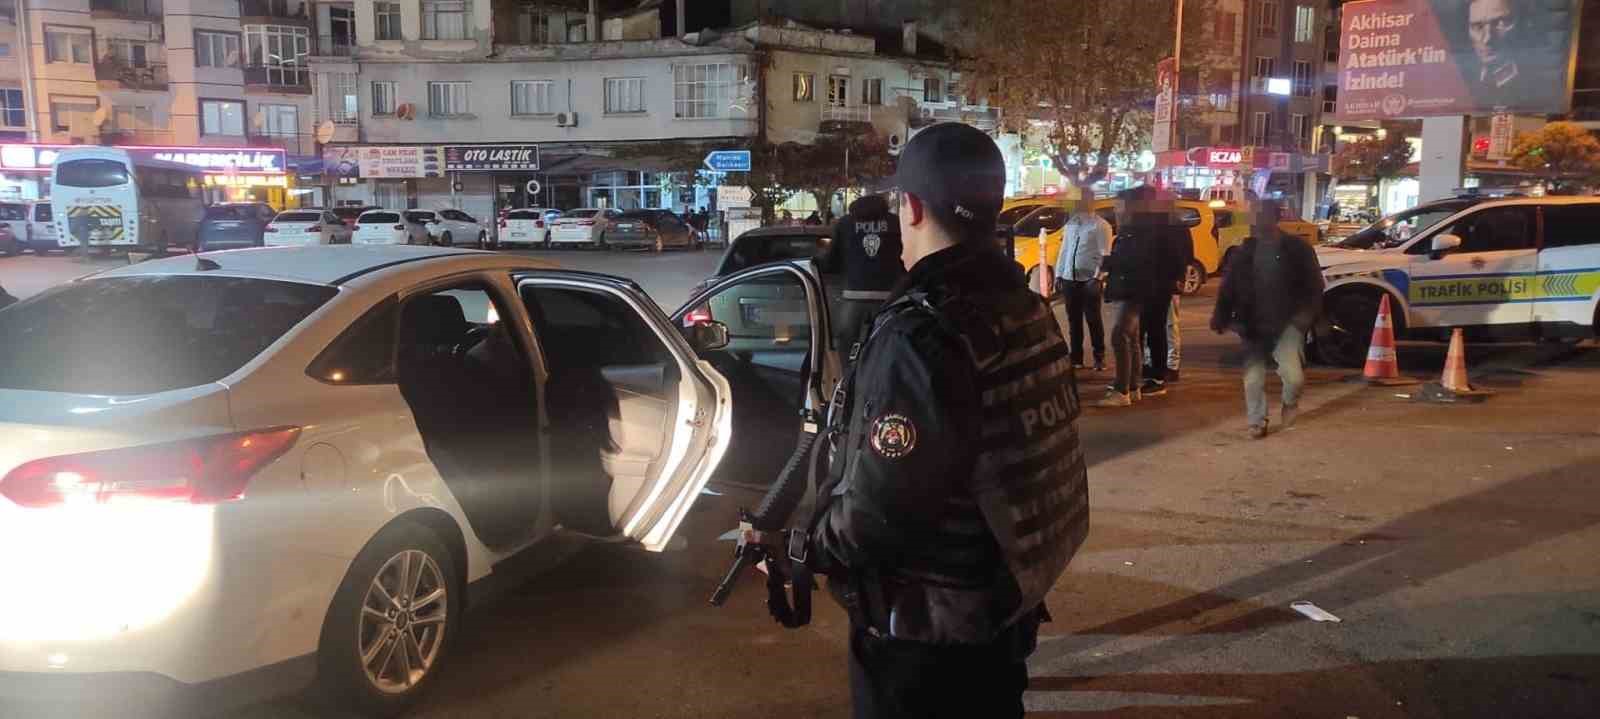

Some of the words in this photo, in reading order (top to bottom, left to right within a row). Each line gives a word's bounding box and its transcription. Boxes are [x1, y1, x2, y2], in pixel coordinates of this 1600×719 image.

[1349, 12, 1414, 31] Akhisar
[1348, 33, 1401, 50] Daima
[1345, 46, 1446, 69] Atatürk'ün
[463, 149, 488, 161] OTO
[489, 146, 532, 161] LASTİK
[1419, 281, 1473, 298] TRAFİK
[1478, 278, 1527, 296] POLİSİ
